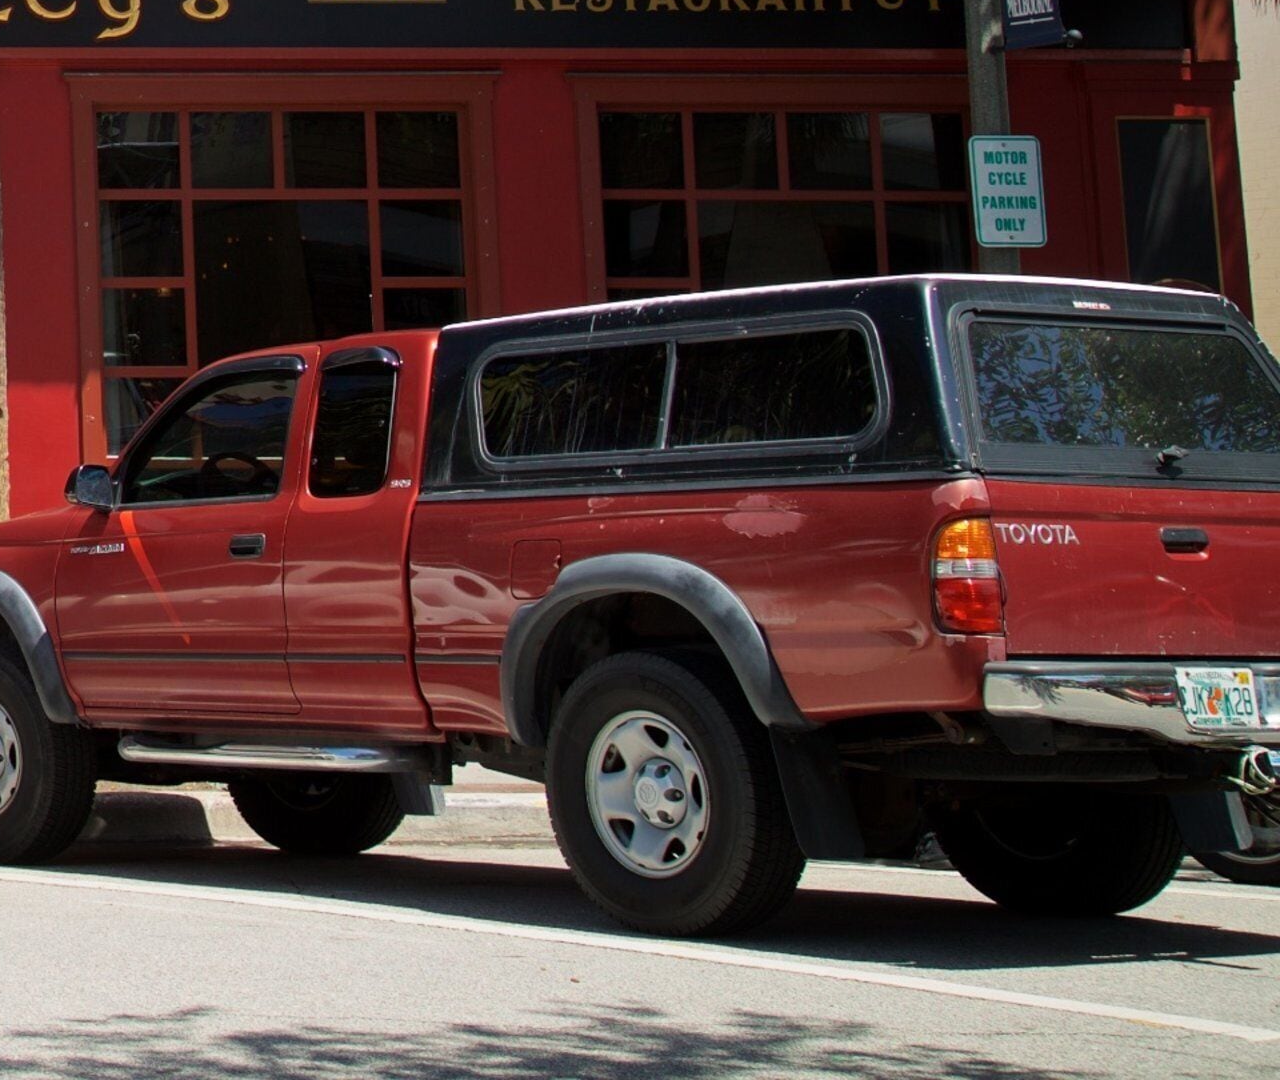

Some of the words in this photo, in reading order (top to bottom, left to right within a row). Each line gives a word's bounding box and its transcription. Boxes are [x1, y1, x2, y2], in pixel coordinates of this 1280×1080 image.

[984, 151, 1028, 164] MOTOR
[988, 172, 1027, 185] CYCLE
[982, 196, 1037, 210] PARKING
[995, 218, 1026, 231] ONLY
[994, 523, 1080, 545] TOYOTA
[1223, 687, 1254, 715] K28
